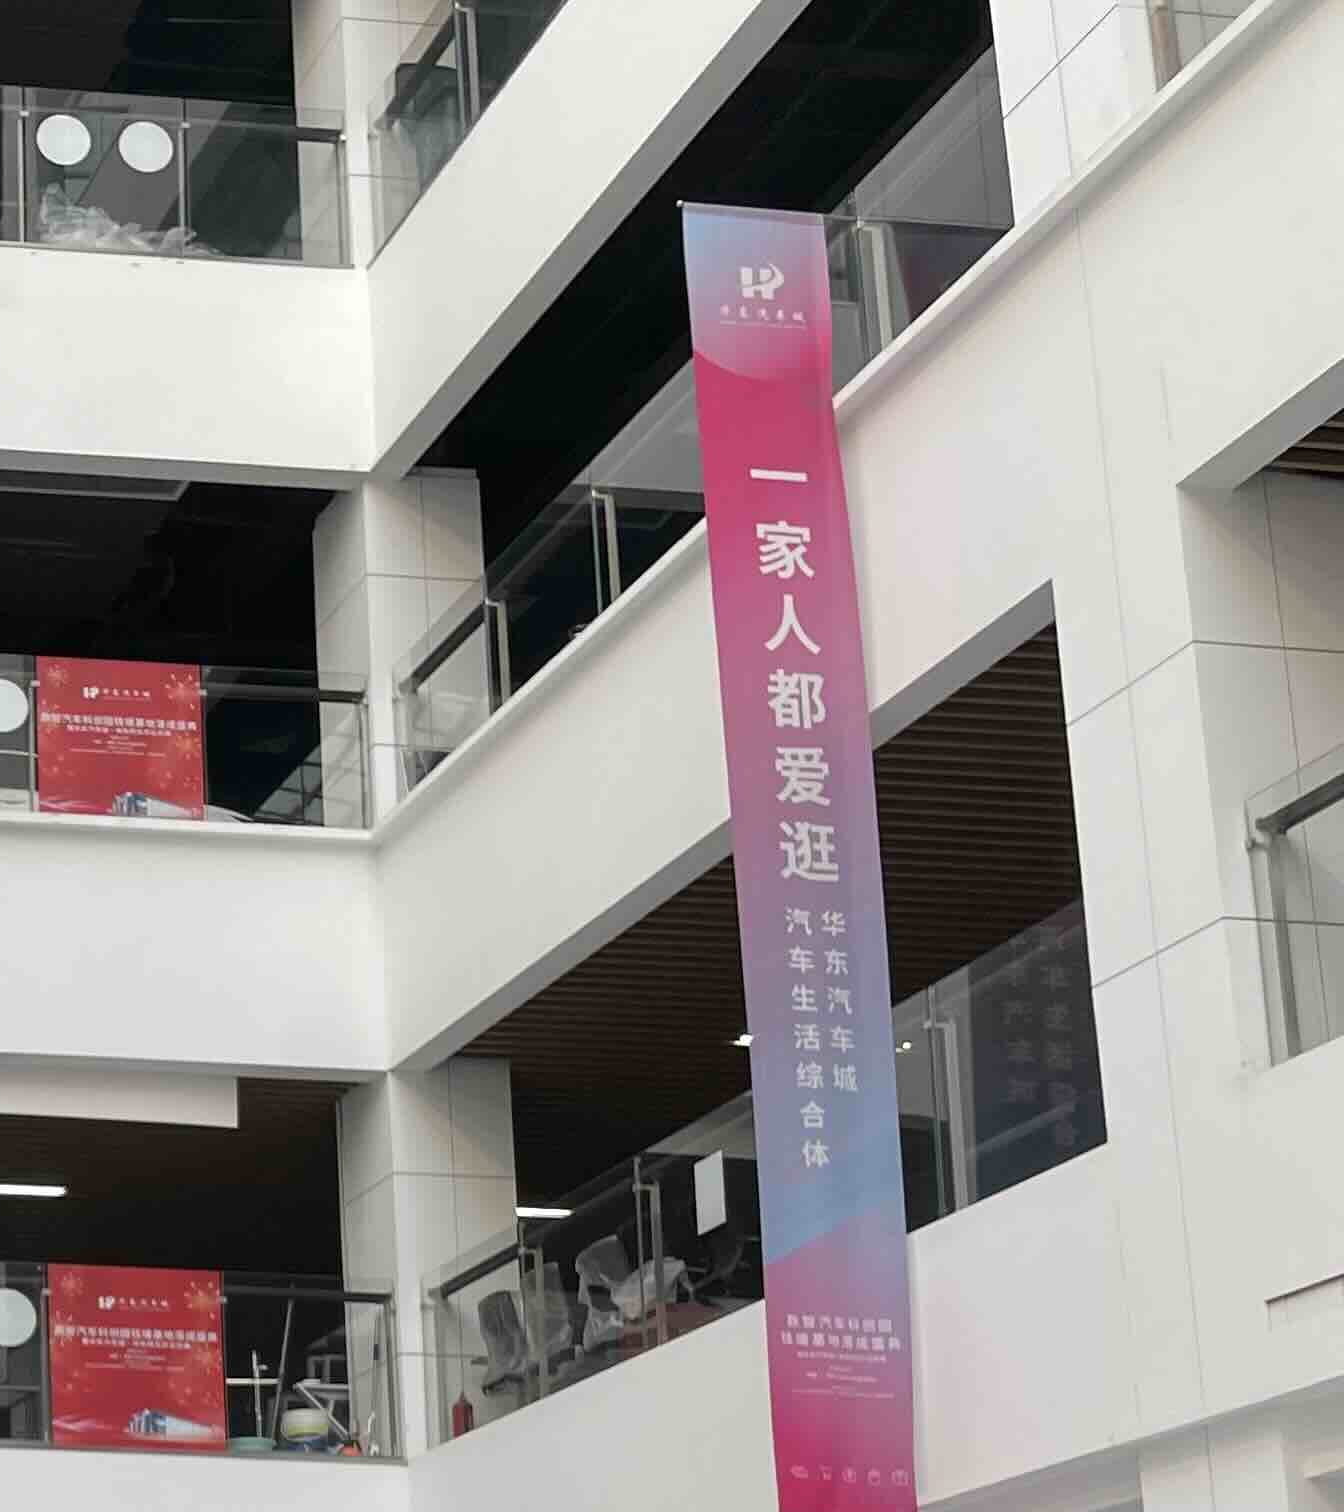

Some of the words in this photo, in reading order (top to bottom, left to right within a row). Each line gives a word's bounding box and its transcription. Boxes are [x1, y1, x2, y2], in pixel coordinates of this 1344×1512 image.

[750, 467, 840, 883] 一家人都爱逛
[784, 907, 832, 1169] 汽车生活综合体
[821, 909, 860, 1093] 华东汽车城
